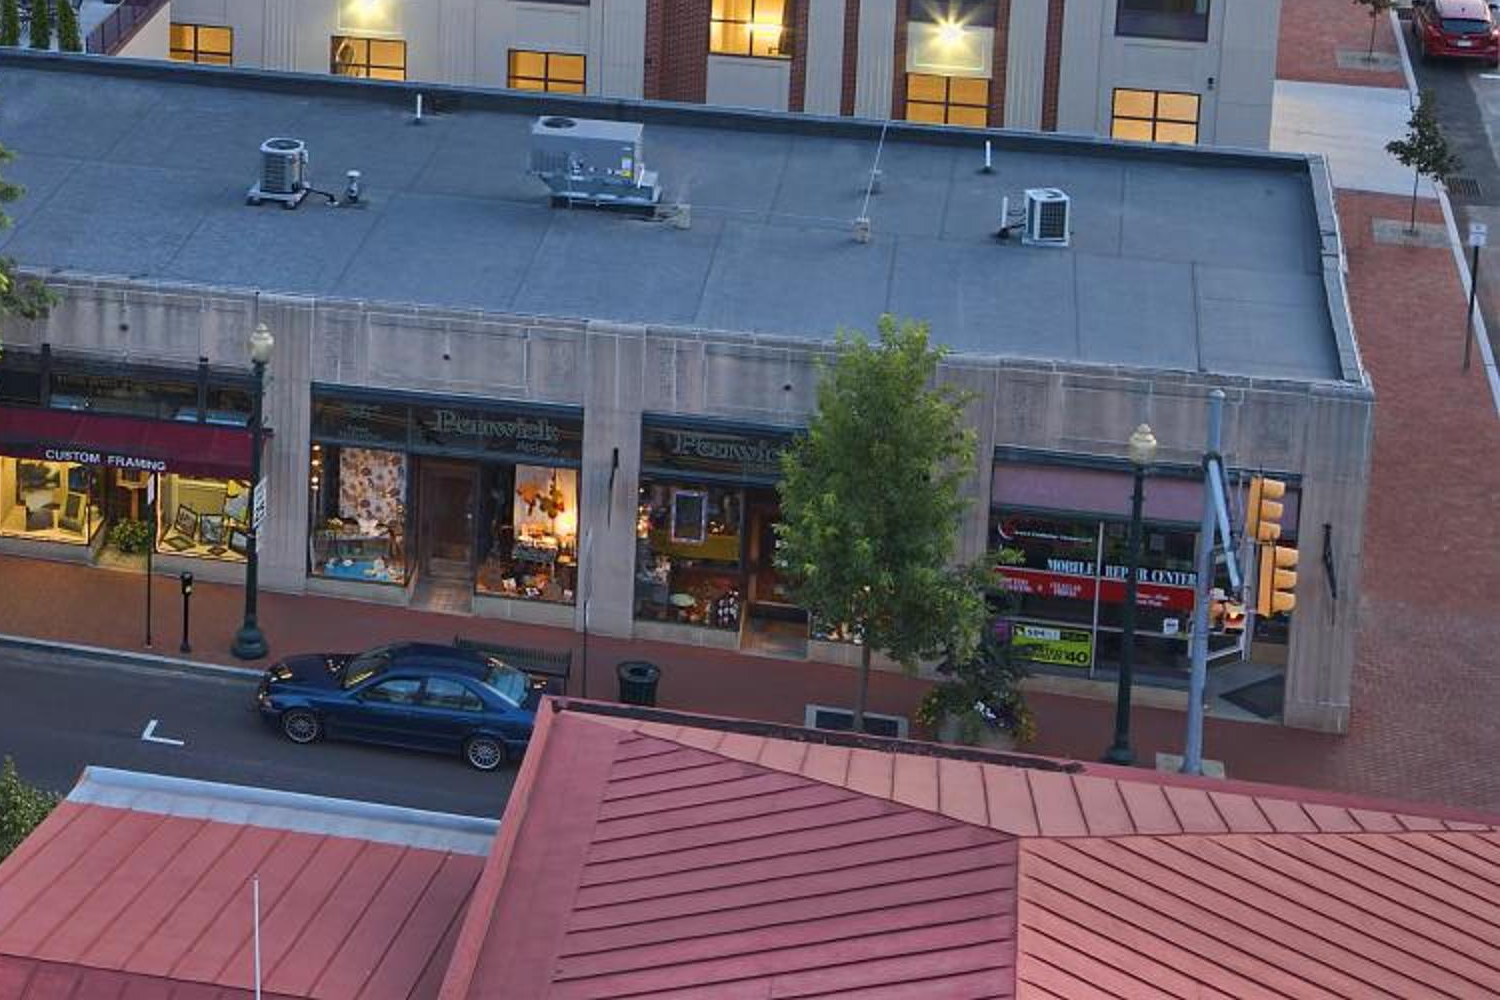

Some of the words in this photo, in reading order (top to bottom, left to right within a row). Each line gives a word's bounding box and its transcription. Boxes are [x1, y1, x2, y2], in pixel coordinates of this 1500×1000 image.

[45, 449, 100, 463] CUSTOM
[107, 455, 166, 471] FRAMING
[1047, 559, 1093, 576] MOBILE
[1151, 568, 1197, 585] CENTER
